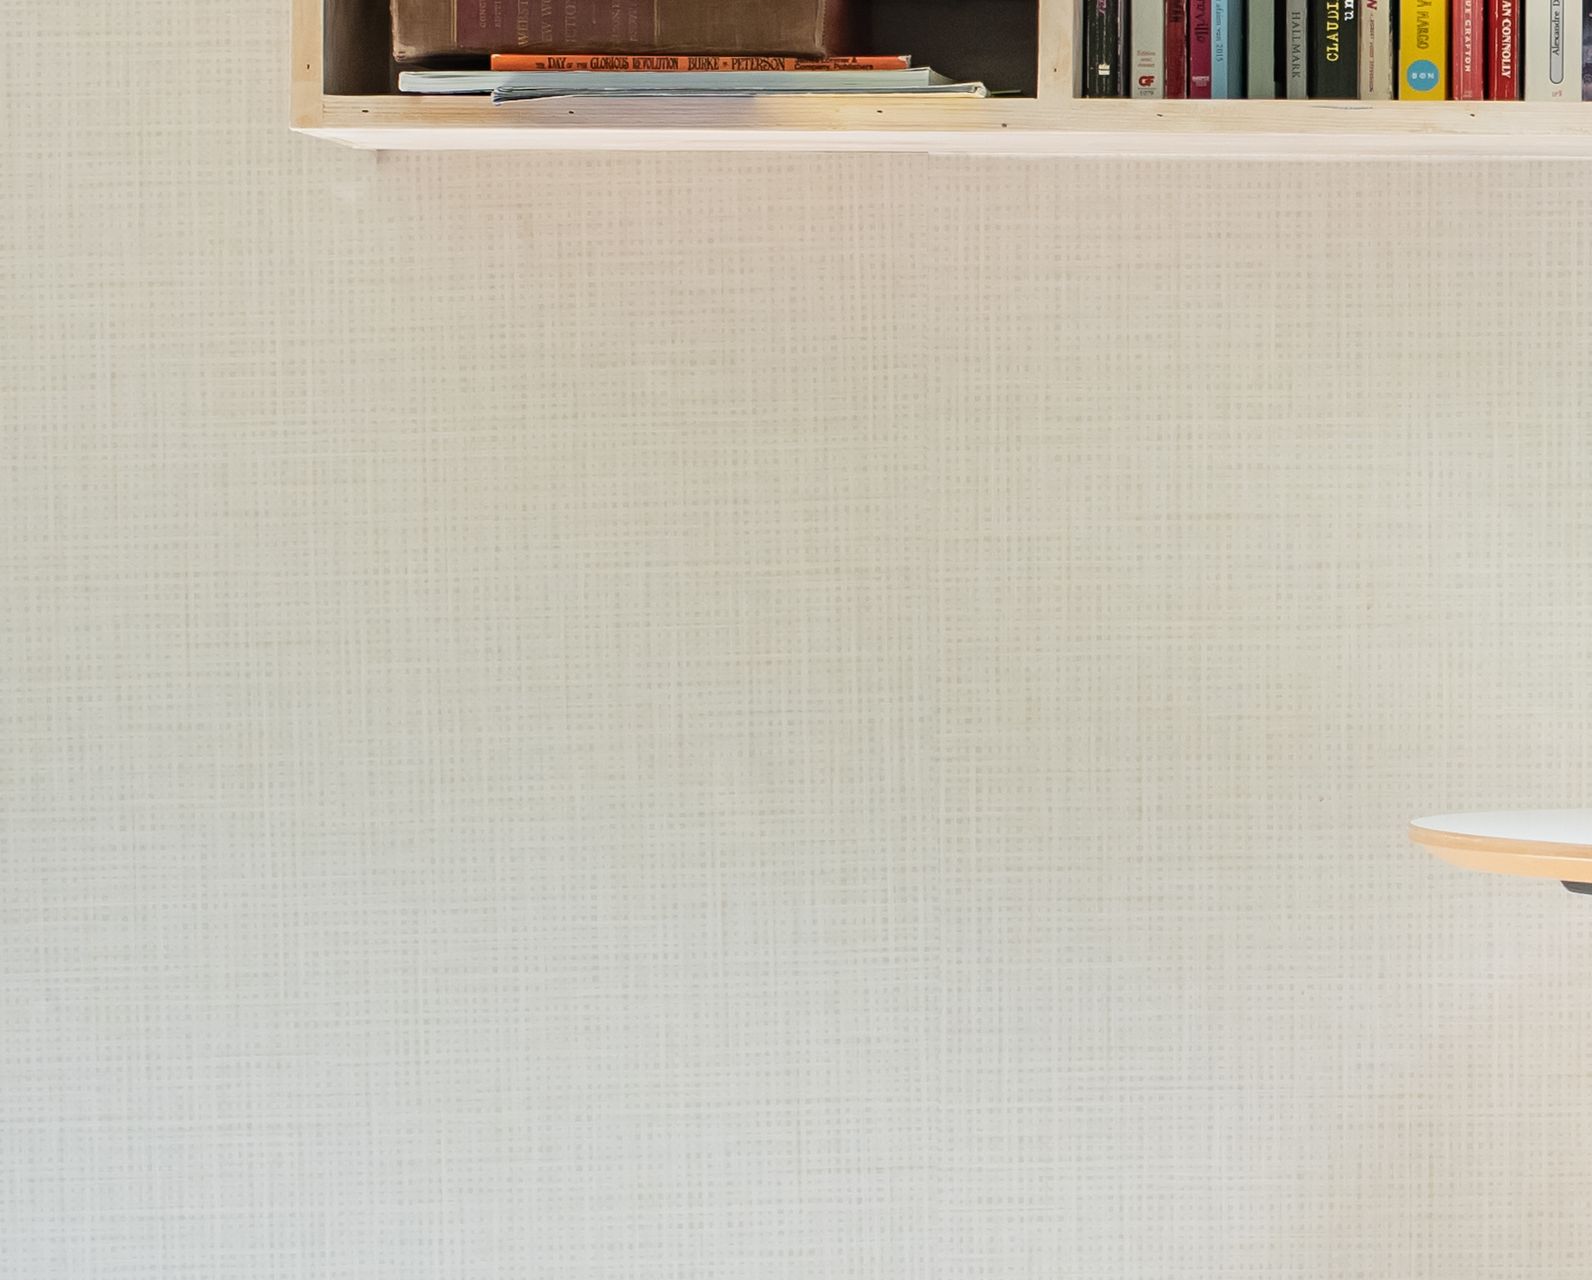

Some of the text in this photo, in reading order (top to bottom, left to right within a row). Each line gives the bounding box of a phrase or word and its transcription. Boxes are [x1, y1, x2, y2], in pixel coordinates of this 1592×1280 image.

[1215, 44, 1224, 62] 2015
[1290, 11, 1302, 79] HALLMARK
[1464, 19, 1472, 72] GRAFTON
[1500, 18, 1512, 79] CONNOLLY
[1551, 10, 1561, 57] Alexandre
[547, 57, 567, 69] DAY
[590, 57, 629, 70] GLORIOUS
[632, 57, 679, 70] REVOLUTION
[687, 57, 719, 70] BURKE
[731, 58, 785, 70] PETERSON
